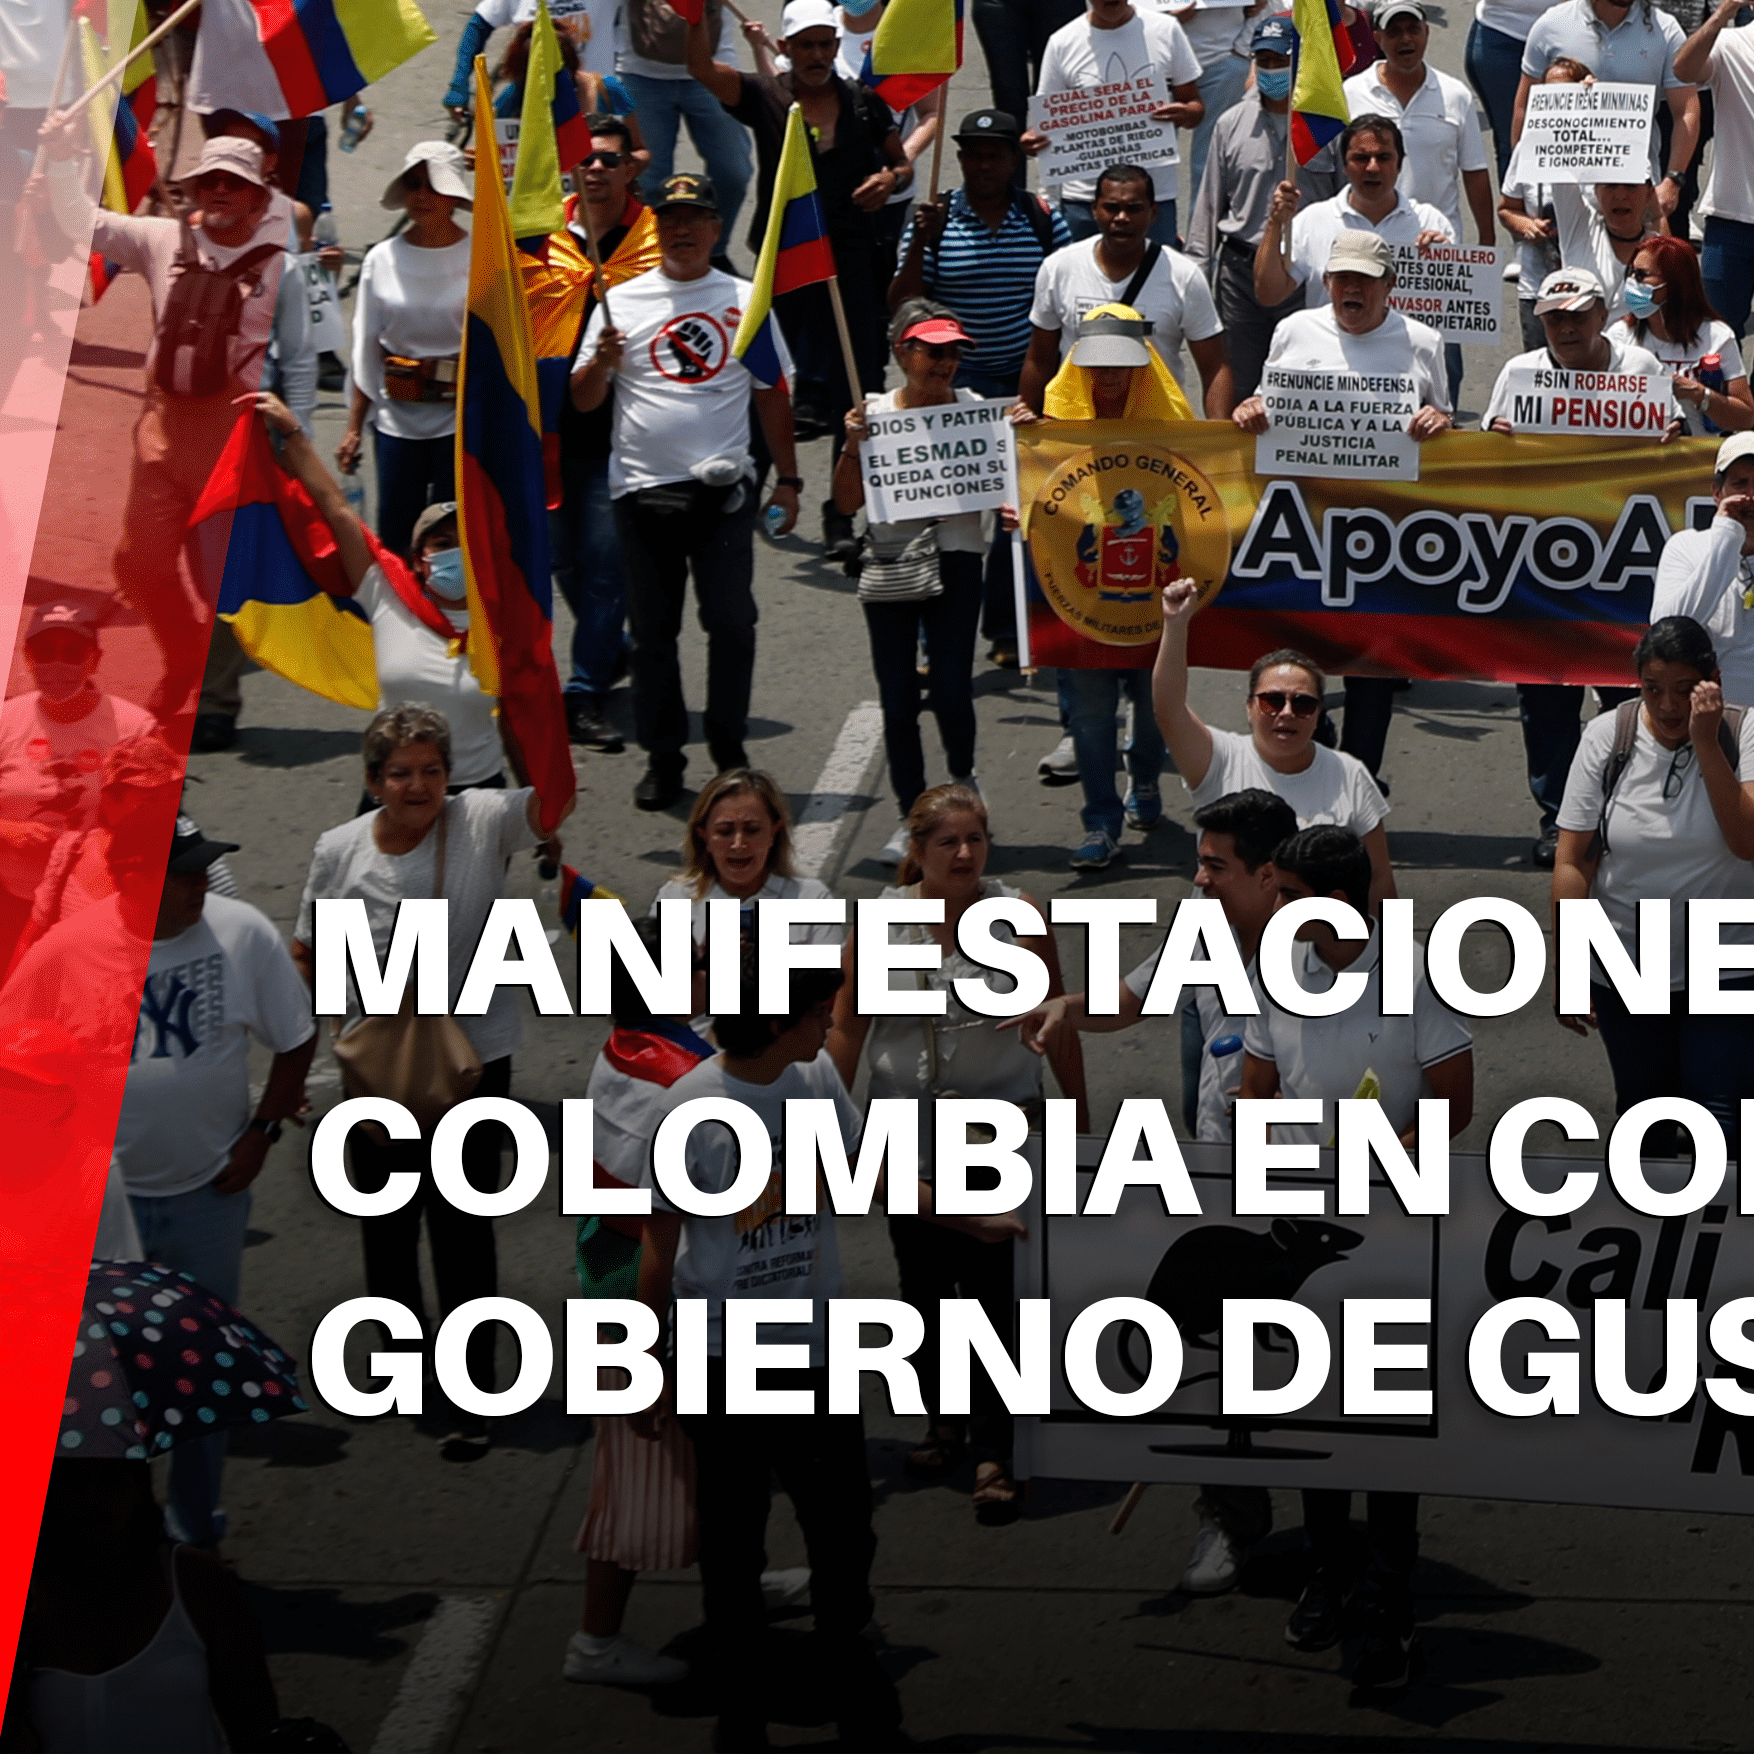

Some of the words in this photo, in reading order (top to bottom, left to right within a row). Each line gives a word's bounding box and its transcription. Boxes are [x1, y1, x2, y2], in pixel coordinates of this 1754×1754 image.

[1601, 91, 1649, 112] MINMINAS
[1527, 118, 1647, 130] DESCONOCIMIENTO
[1552, 130, 1611, 143] TOTAL...
[1535, 144, 1631, 156] INCOMPETENTE
[1549, 156, 1624, 168] IGNORANTE.
[1267, 371, 1334, 391] #RENUNCIE
[1337, 375, 1415, 394] MINDEFENSA
[1533, 370, 1570, 389] #SIN
[1574, 373, 1648, 394] ROBARSE
[1265, 396, 1304, 412] ODIA
[1324, 400, 1345, 413] LA
[1350, 401, 1415, 416] FUERZA
[1514, 395, 1543, 425] MI
[1551, 394, 1666, 431] PENSIÓN
[1274, 412, 1345, 431] PÚBLICA
[1382, 420, 1403, 433] LA
[1299, 434, 1376, 450] JUSTICIA
[867, 454, 892, 469] EL
[896, 438, 988, 466] ESMAD
[1275, 448, 1329, 465] PENAL
[1332, 453, 1400, 468] MILITAR
[868, 468, 935, 488] QUEDA
[940, 462, 981, 480] CON
[893, 477, 1006, 503] FUNCIONES
[1043, 453, 1130, 516] COMANDO
[1135, 455, 1213, 522] GENERAL
